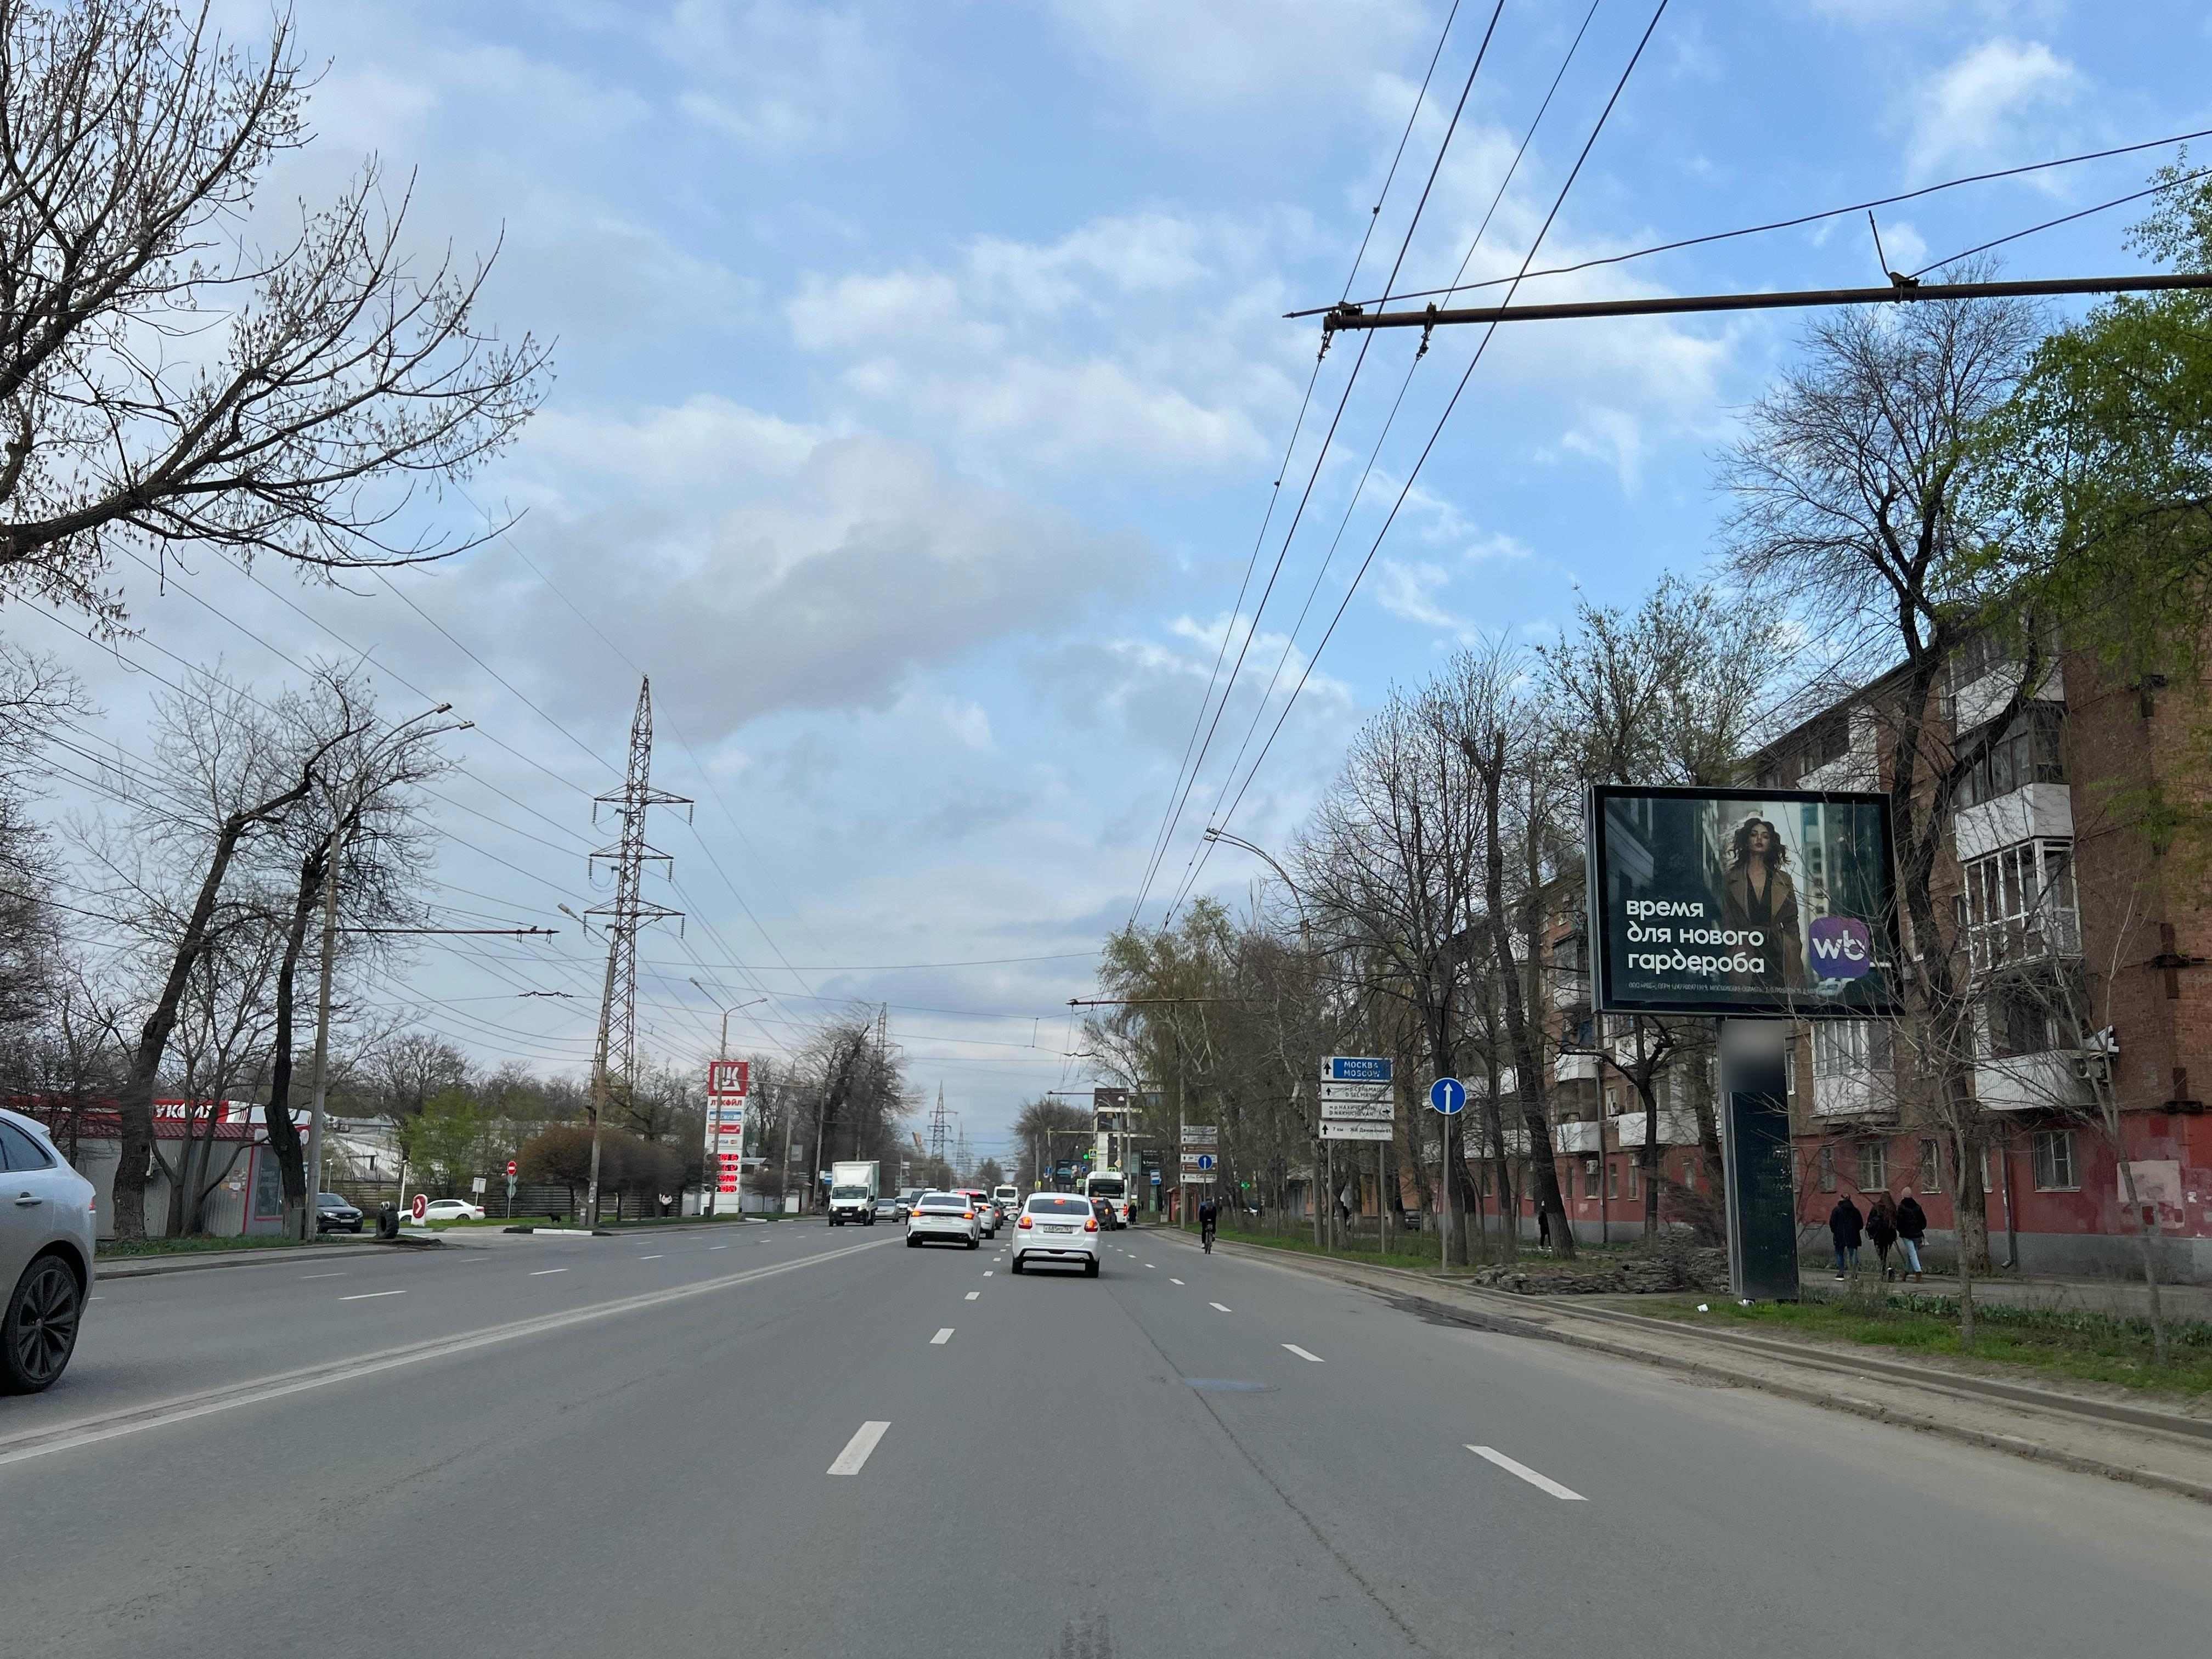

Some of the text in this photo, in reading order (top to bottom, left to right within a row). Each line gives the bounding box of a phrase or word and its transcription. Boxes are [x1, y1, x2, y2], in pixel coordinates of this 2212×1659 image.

[1626, 900, 1704, 921] время
[1627, 921, 1764, 946] для нового
[1628, 949, 1765, 976] гардероба
[1344, 1069, 1381, 1077] MOSCOW
